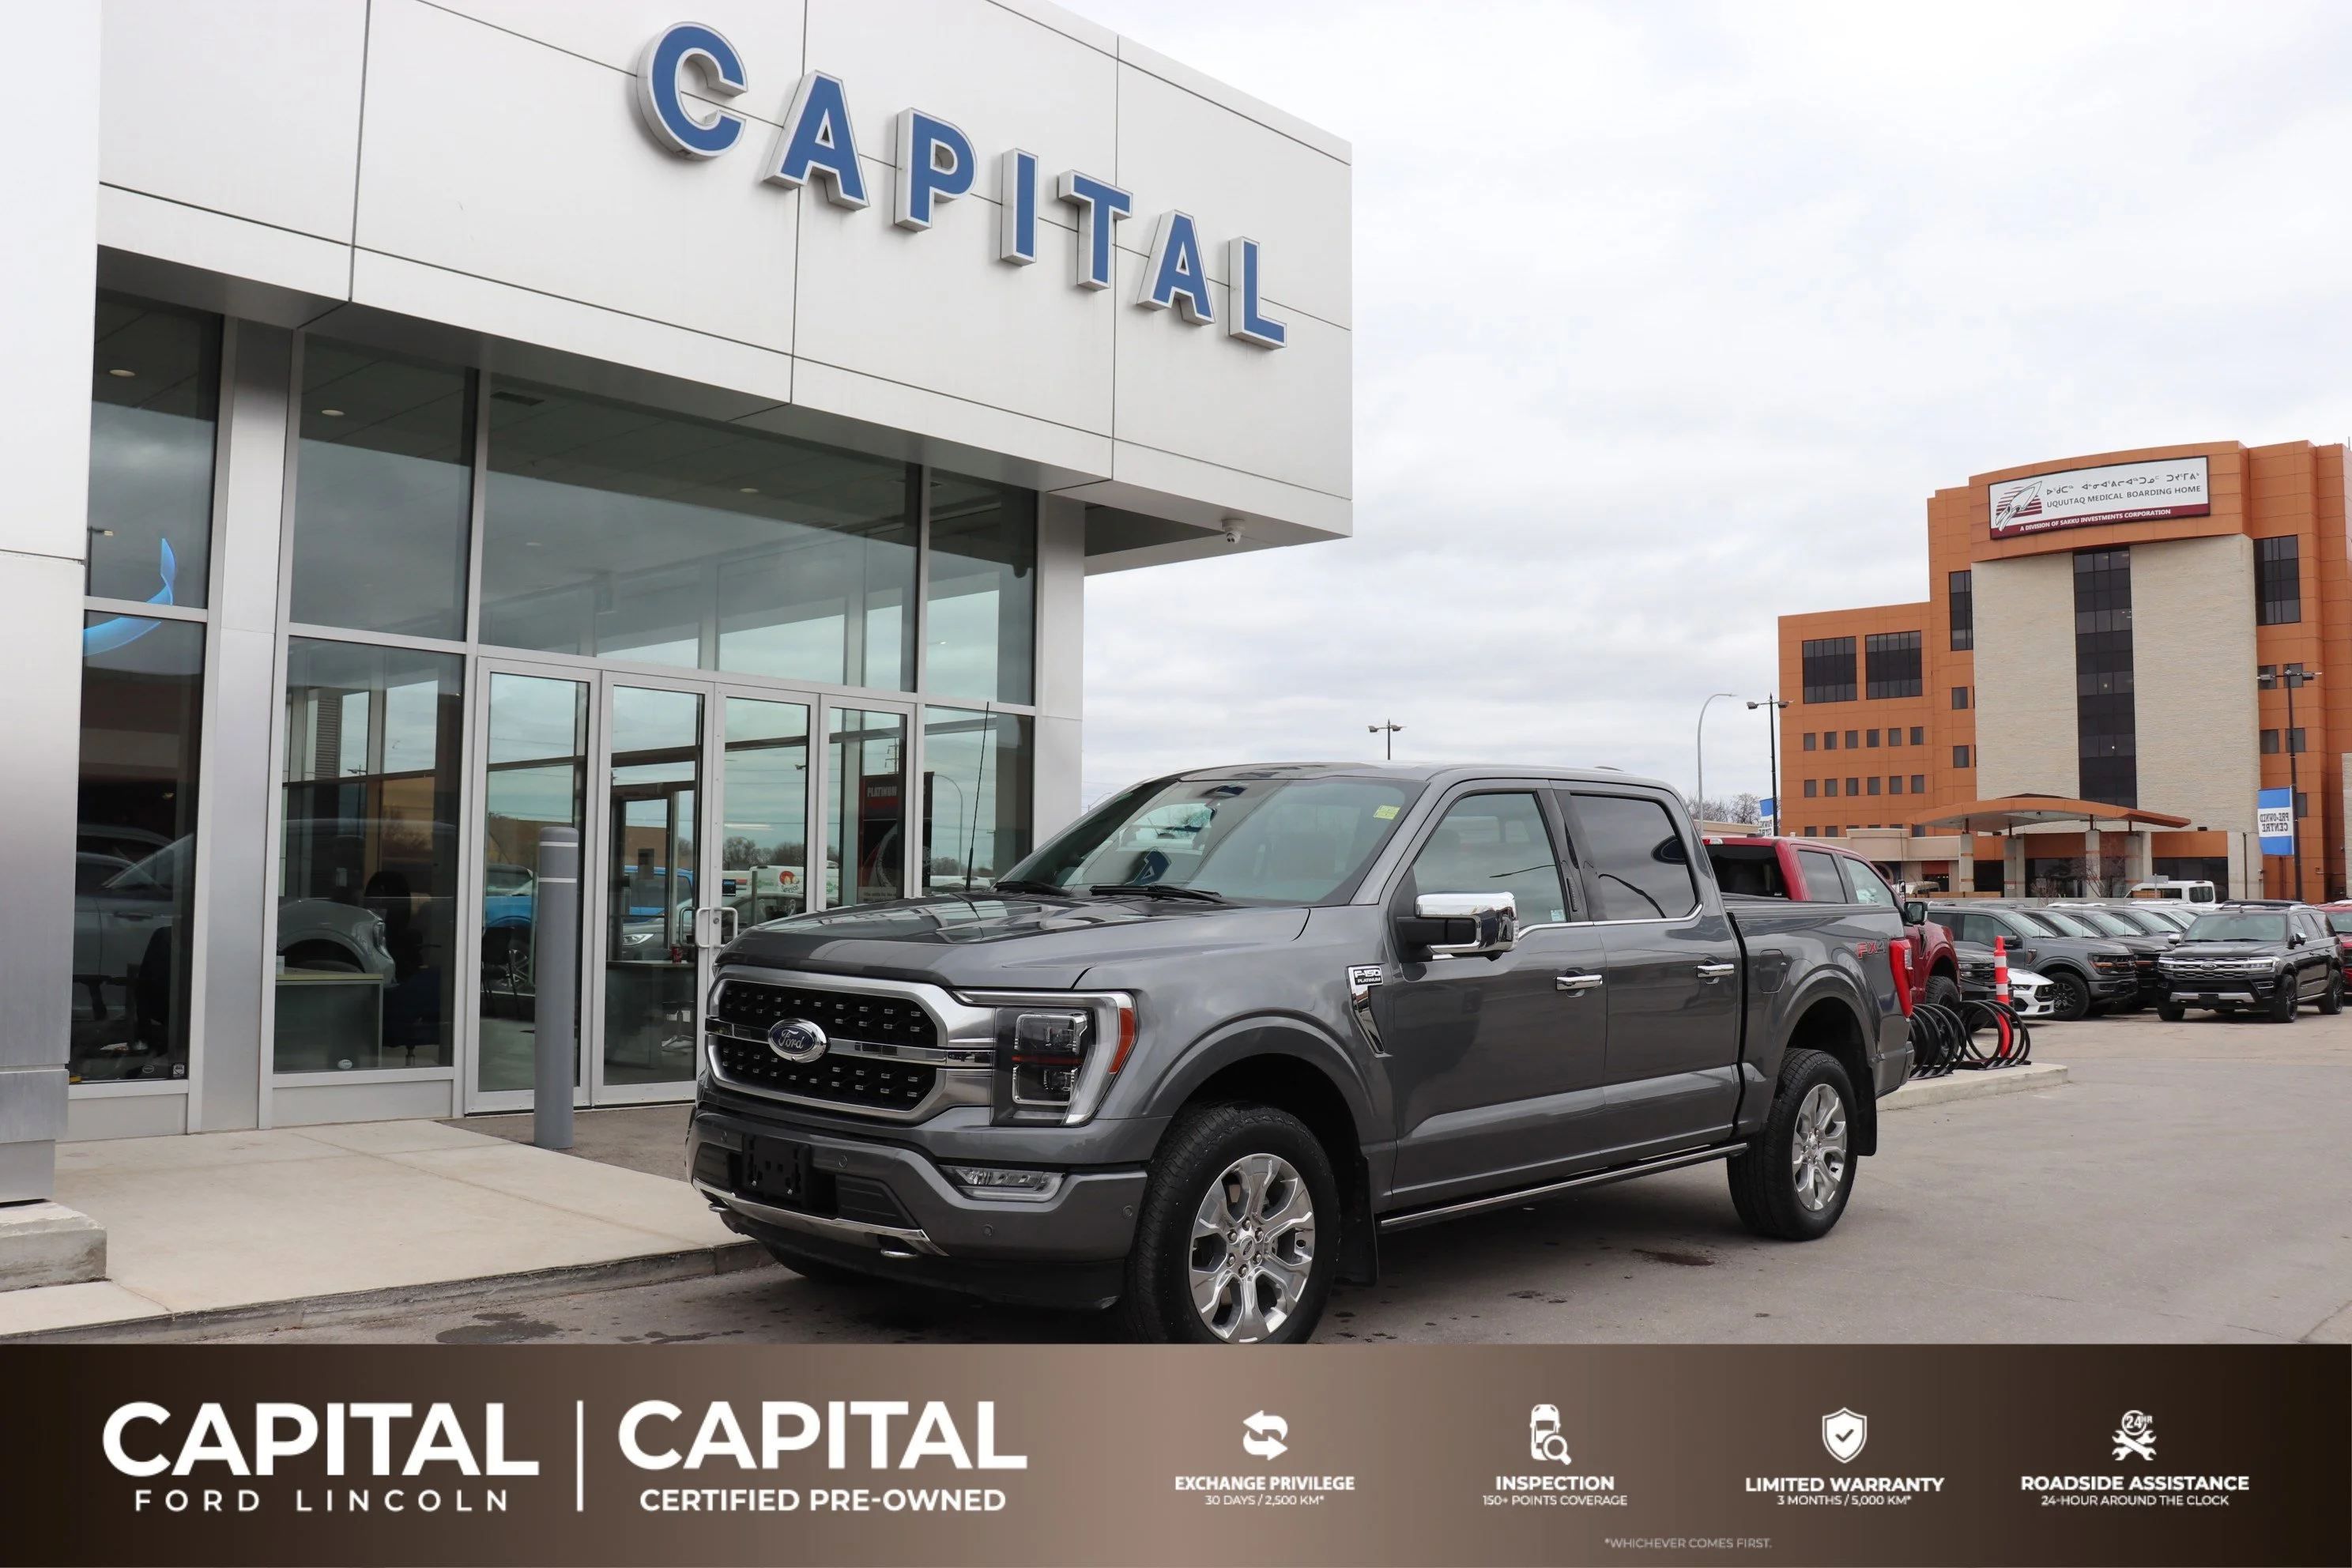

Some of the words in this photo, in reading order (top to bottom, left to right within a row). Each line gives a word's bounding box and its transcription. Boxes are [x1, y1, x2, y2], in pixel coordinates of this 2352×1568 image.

[636, 21, 1287, 349] CAPITAL
[2046, 496, 2086, 508] UQUUTAQ
[2087, 492, 2124, 503] MEDICAL
[2127, 488, 2172, 498] BOARDING
[2174, 485, 2201, 494] HOME
[2025, 522, 2050, 531] DIVISION
[2080, 513, 2124, 523] INVESTMENTS
[2124, 508, 2172, 518] CORPORATION
[867, 786, 897, 797] PLATINUM
[1856, 940, 1886, 960] FX4
[1354, 969, 1381, 978] F-150
[778, 1029, 805, 1050] Ford
